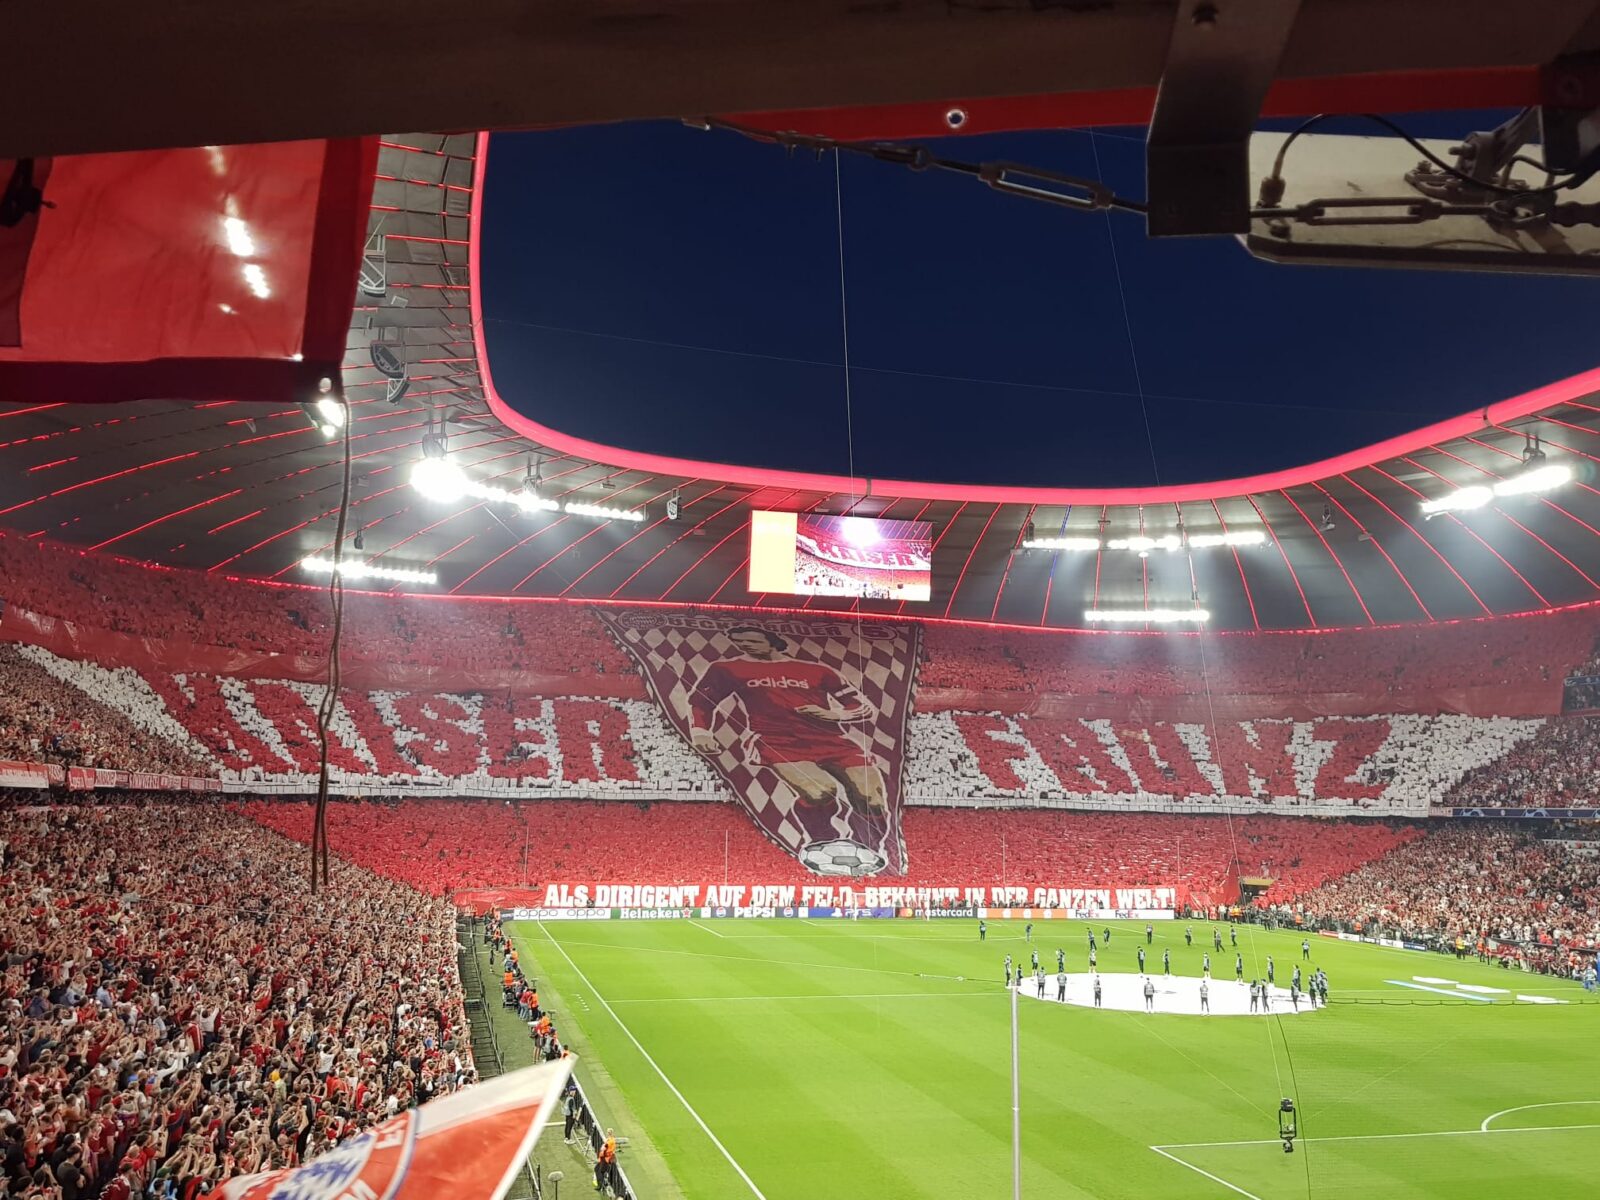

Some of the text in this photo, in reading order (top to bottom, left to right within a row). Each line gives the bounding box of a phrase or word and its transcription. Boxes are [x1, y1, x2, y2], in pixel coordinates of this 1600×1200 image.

[747, 676, 809, 689] adidas
[544, 884, 587, 907] ALS
[595, 885, 699, 907] DIRIGENT
[708, 886, 745, 907] AUF
[750, 886, 795, 908] DEM
[801, 886, 853, 907] FELD
[865, 887, 960, 908] BEKANNT
[964, 887, 986, 908] IN
[991, 887, 1029, 908] DER
[1034, 888, 1111, 909] GANZEN
[519, 909, 558, 919] oppo
[567, 909, 605, 919] oppo
[620, 907, 680, 919] Heineken
[1075, 908, 1140, 919] FedEx FedEx
